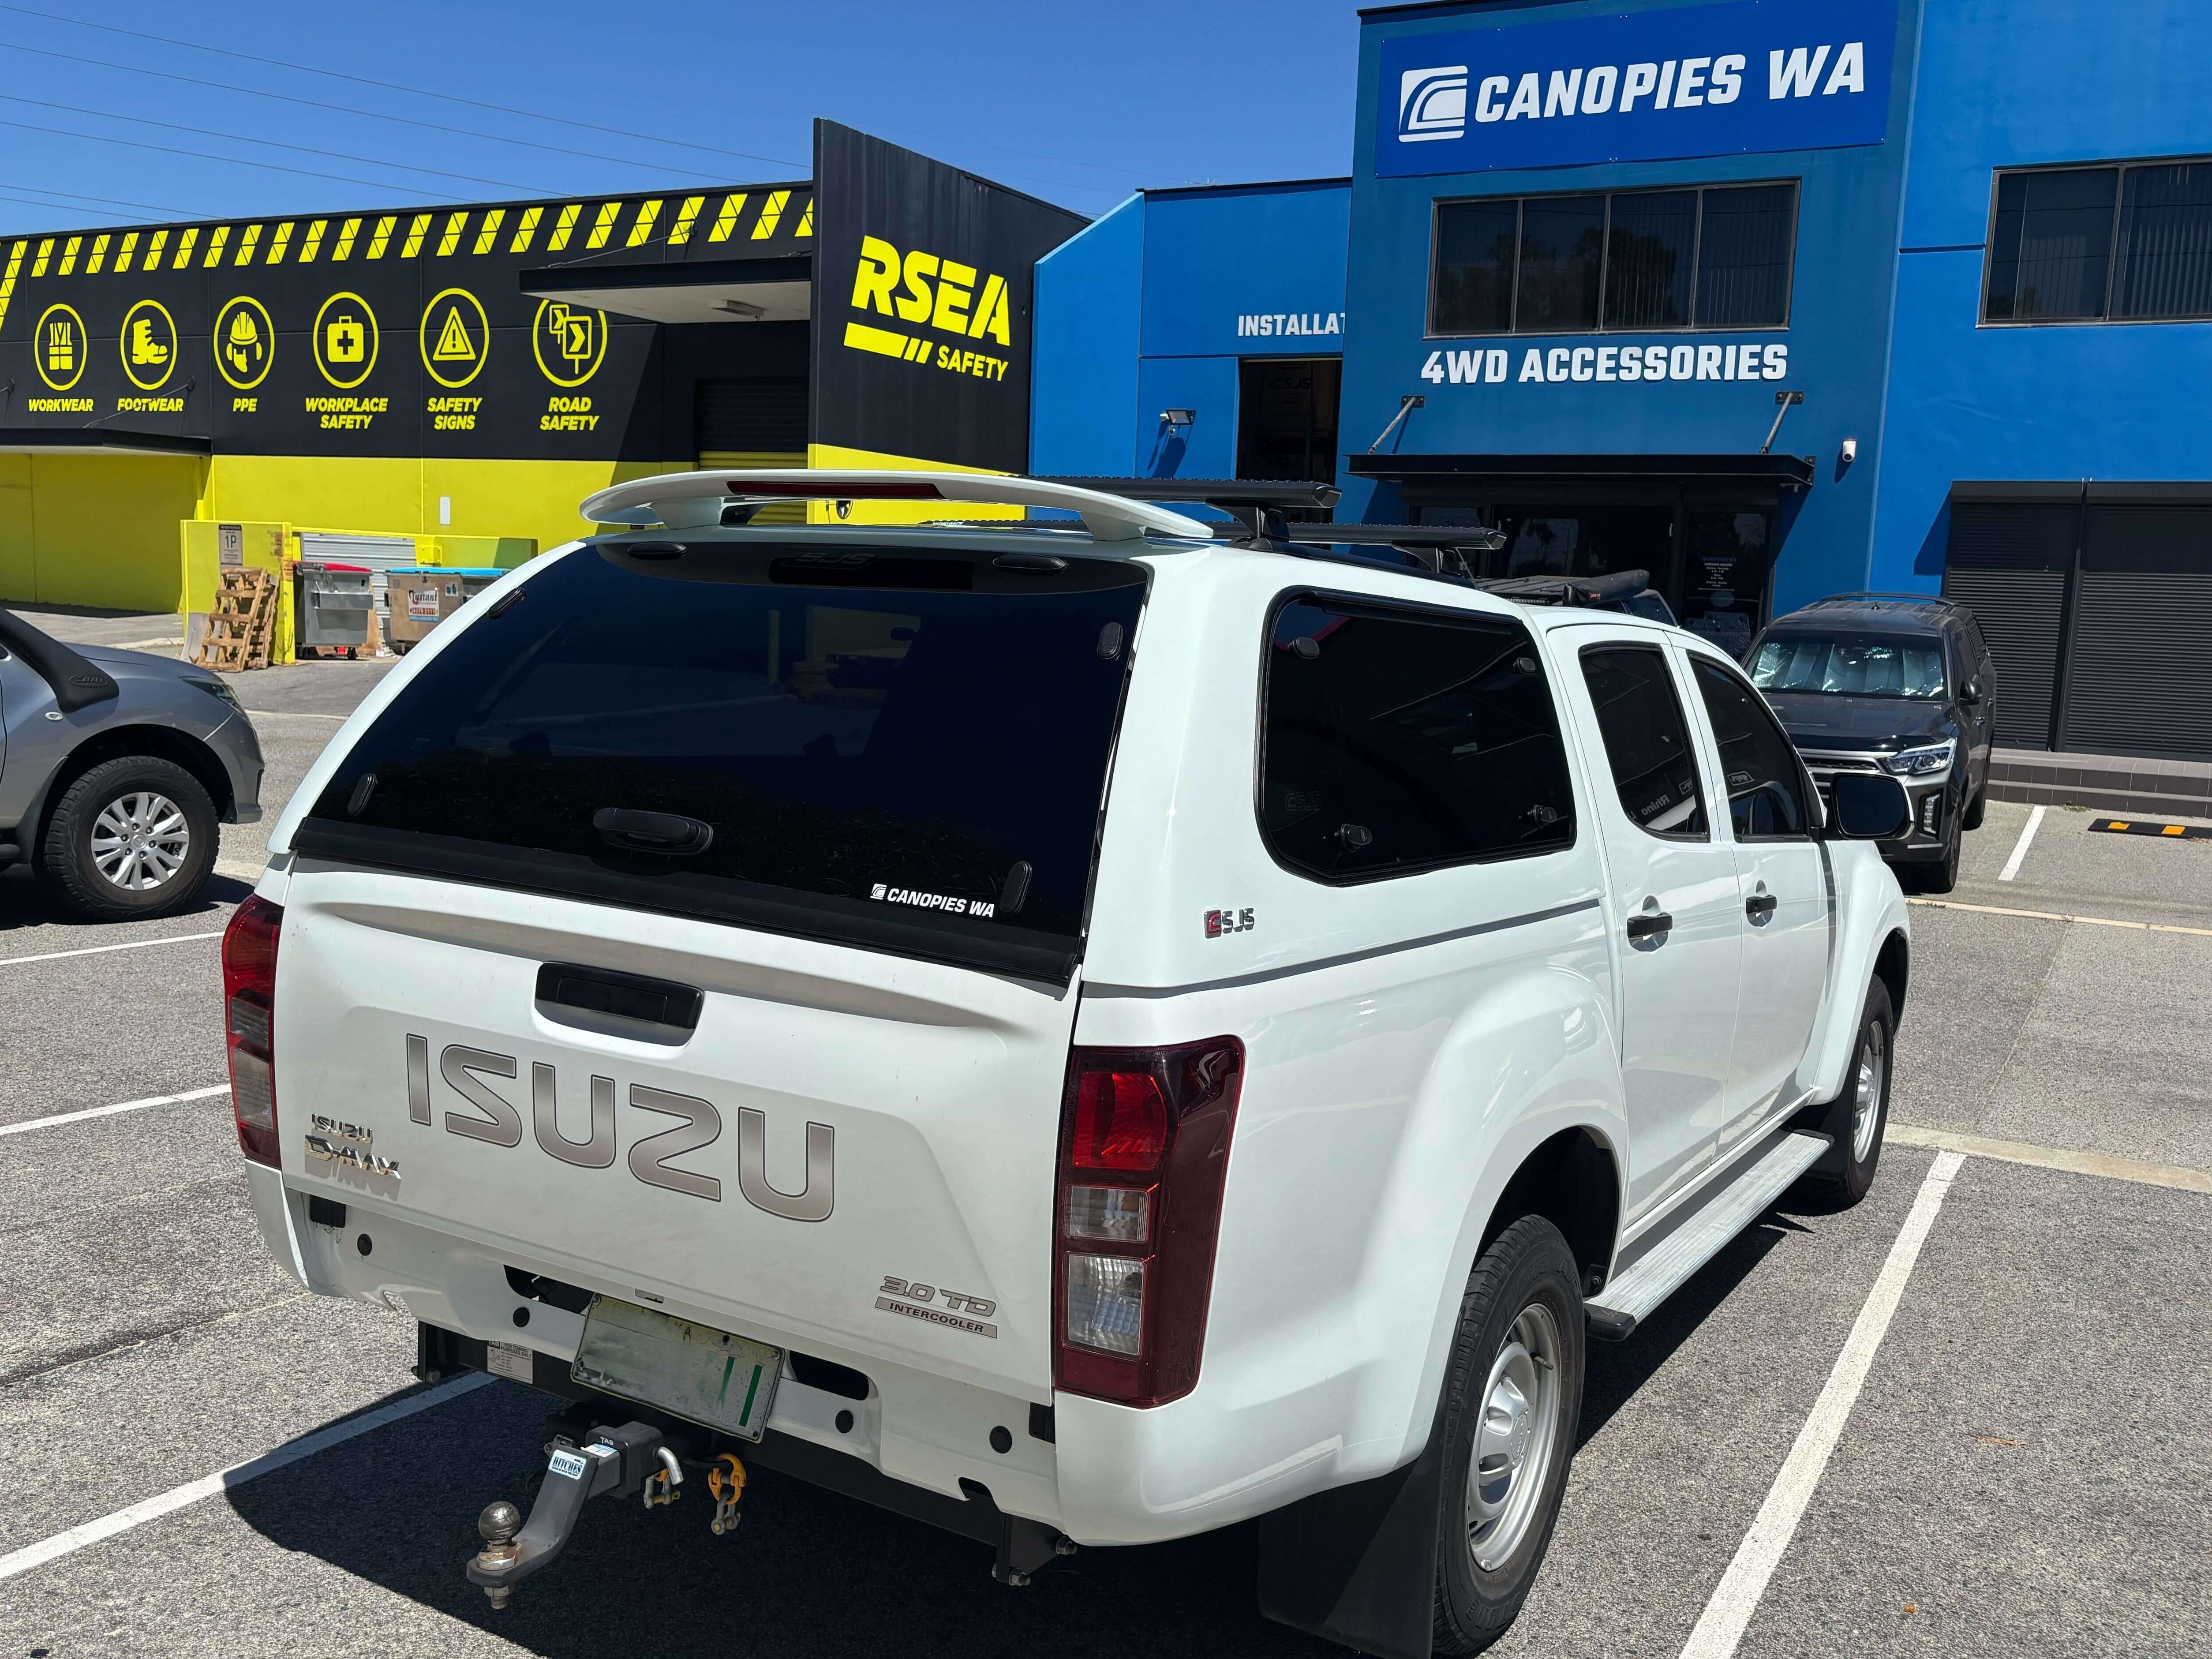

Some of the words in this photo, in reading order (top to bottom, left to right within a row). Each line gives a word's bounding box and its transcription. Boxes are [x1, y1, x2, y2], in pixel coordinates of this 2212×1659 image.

[1474, 54, 1745, 123] CANOPIES
[1769, 41, 1864, 100] WA
[851, 235, 1010, 346] RSEA
[936, 345, 1008, 382] SAFETY
[1420, 348, 1508, 385] 4WD
[1518, 344, 1787, 382] ACCESSORIES
[28, 399, 94, 412] WORKWEAR
[117, 398, 184, 412] FOOTWEAR
[232, 398, 258, 412] PPE
[305, 398, 388, 412] WORKPLACE
[427, 397, 482, 412] SAFETY
[548, 397, 591, 412] ROAD
[320, 415, 373, 430] SAFETY
[434, 415, 475, 430] SIGNS
[539, 415, 600, 431] SAFETY
[225, 535, 236, 548] 1P
[887, 888, 967, 913] CANOPIES
[969, 901, 995, 918] WA
[311, 1113, 373, 1143] ISUZU
[406, 1033, 835, 1222] ISUZU
[305, 1135, 401, 1180] D-MAX
[880, 1275, 936, 1302] 3.0
[939, 1288, 996, 1317] TD
[890, 1302, 984, 1332] INTERCOOLER
[553, 1457, 582, 1474] HITCHES
